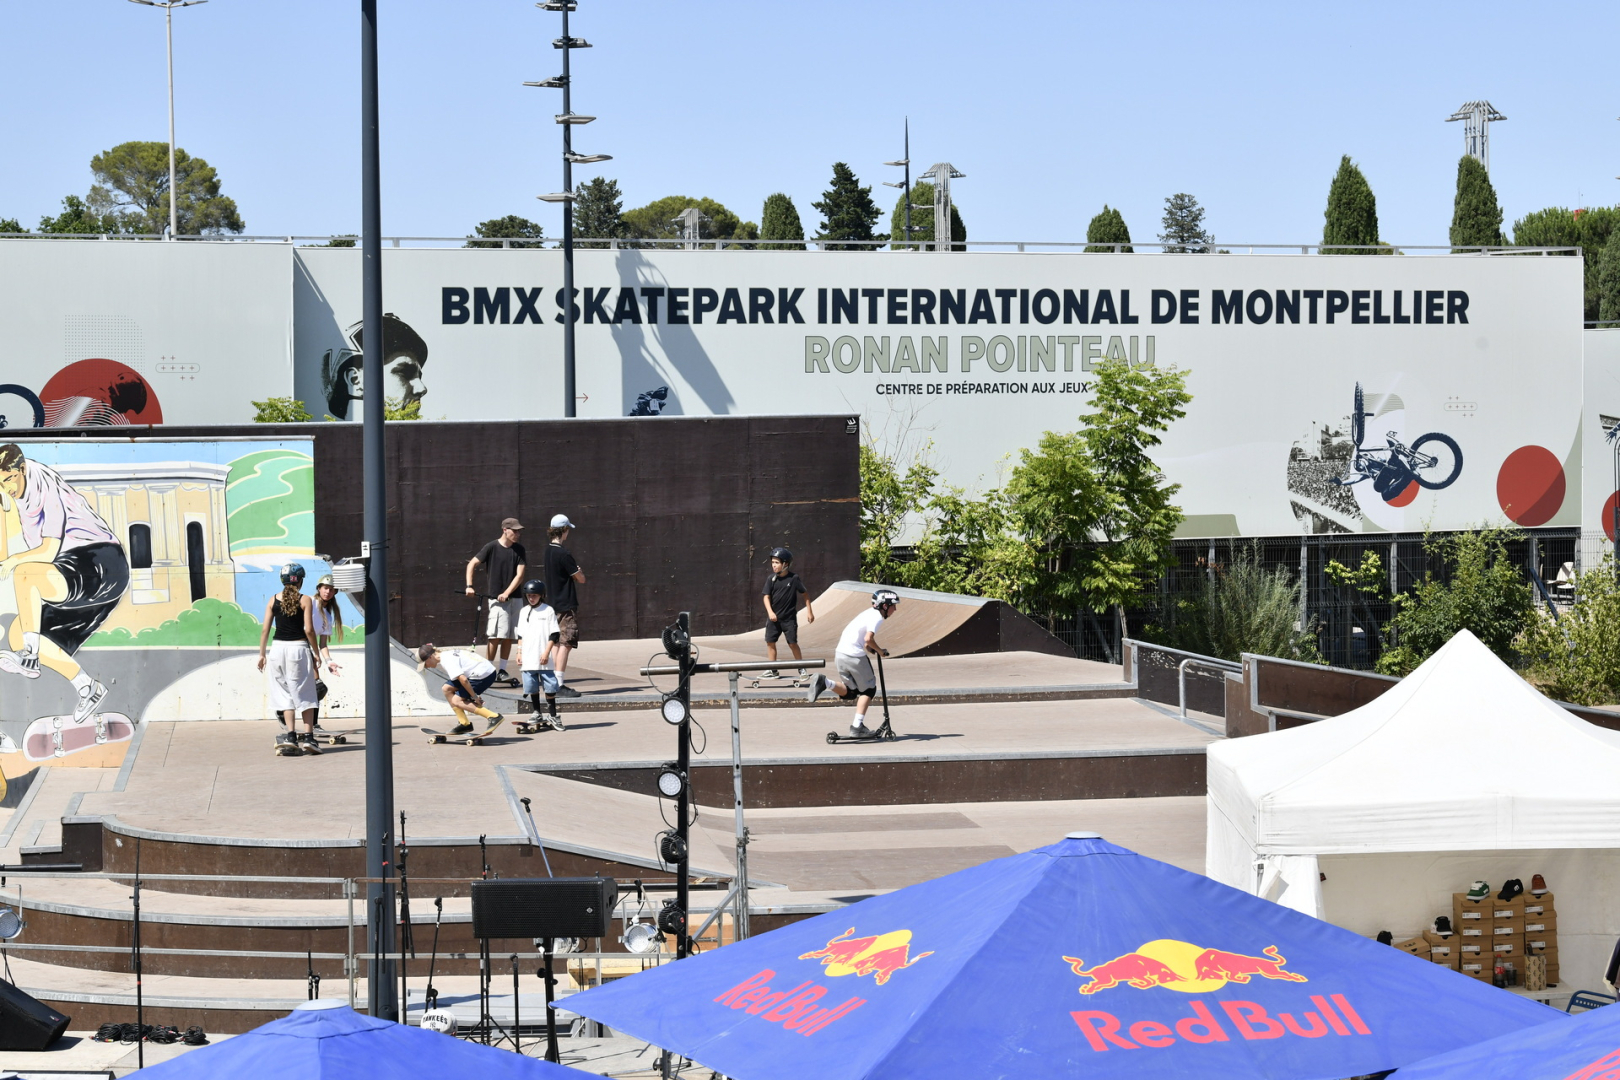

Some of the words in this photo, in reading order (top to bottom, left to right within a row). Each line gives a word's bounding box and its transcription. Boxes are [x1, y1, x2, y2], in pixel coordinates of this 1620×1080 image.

[442, 287, 543, 325] BMX
[554, 287, 806, 325] SKATEPARK
[817, 288, 1139, 325] INTERNATIONAL
[1151, 289, 1200, 325] DE
[1211, 289, 1470, 325] MONTPELLIER
[804, 334, 949, 374] RONAN
[960, 334, 1156, 373] POINTEAU
[875, 383, 923, 395] CENTRE
[926, 383, 943, 395] DE
[945, 379, 1028, 395] PRÉPARATION
[1031, 382, 1056, 394] AUX
[1058, 382, 1089, 394] JEUX
